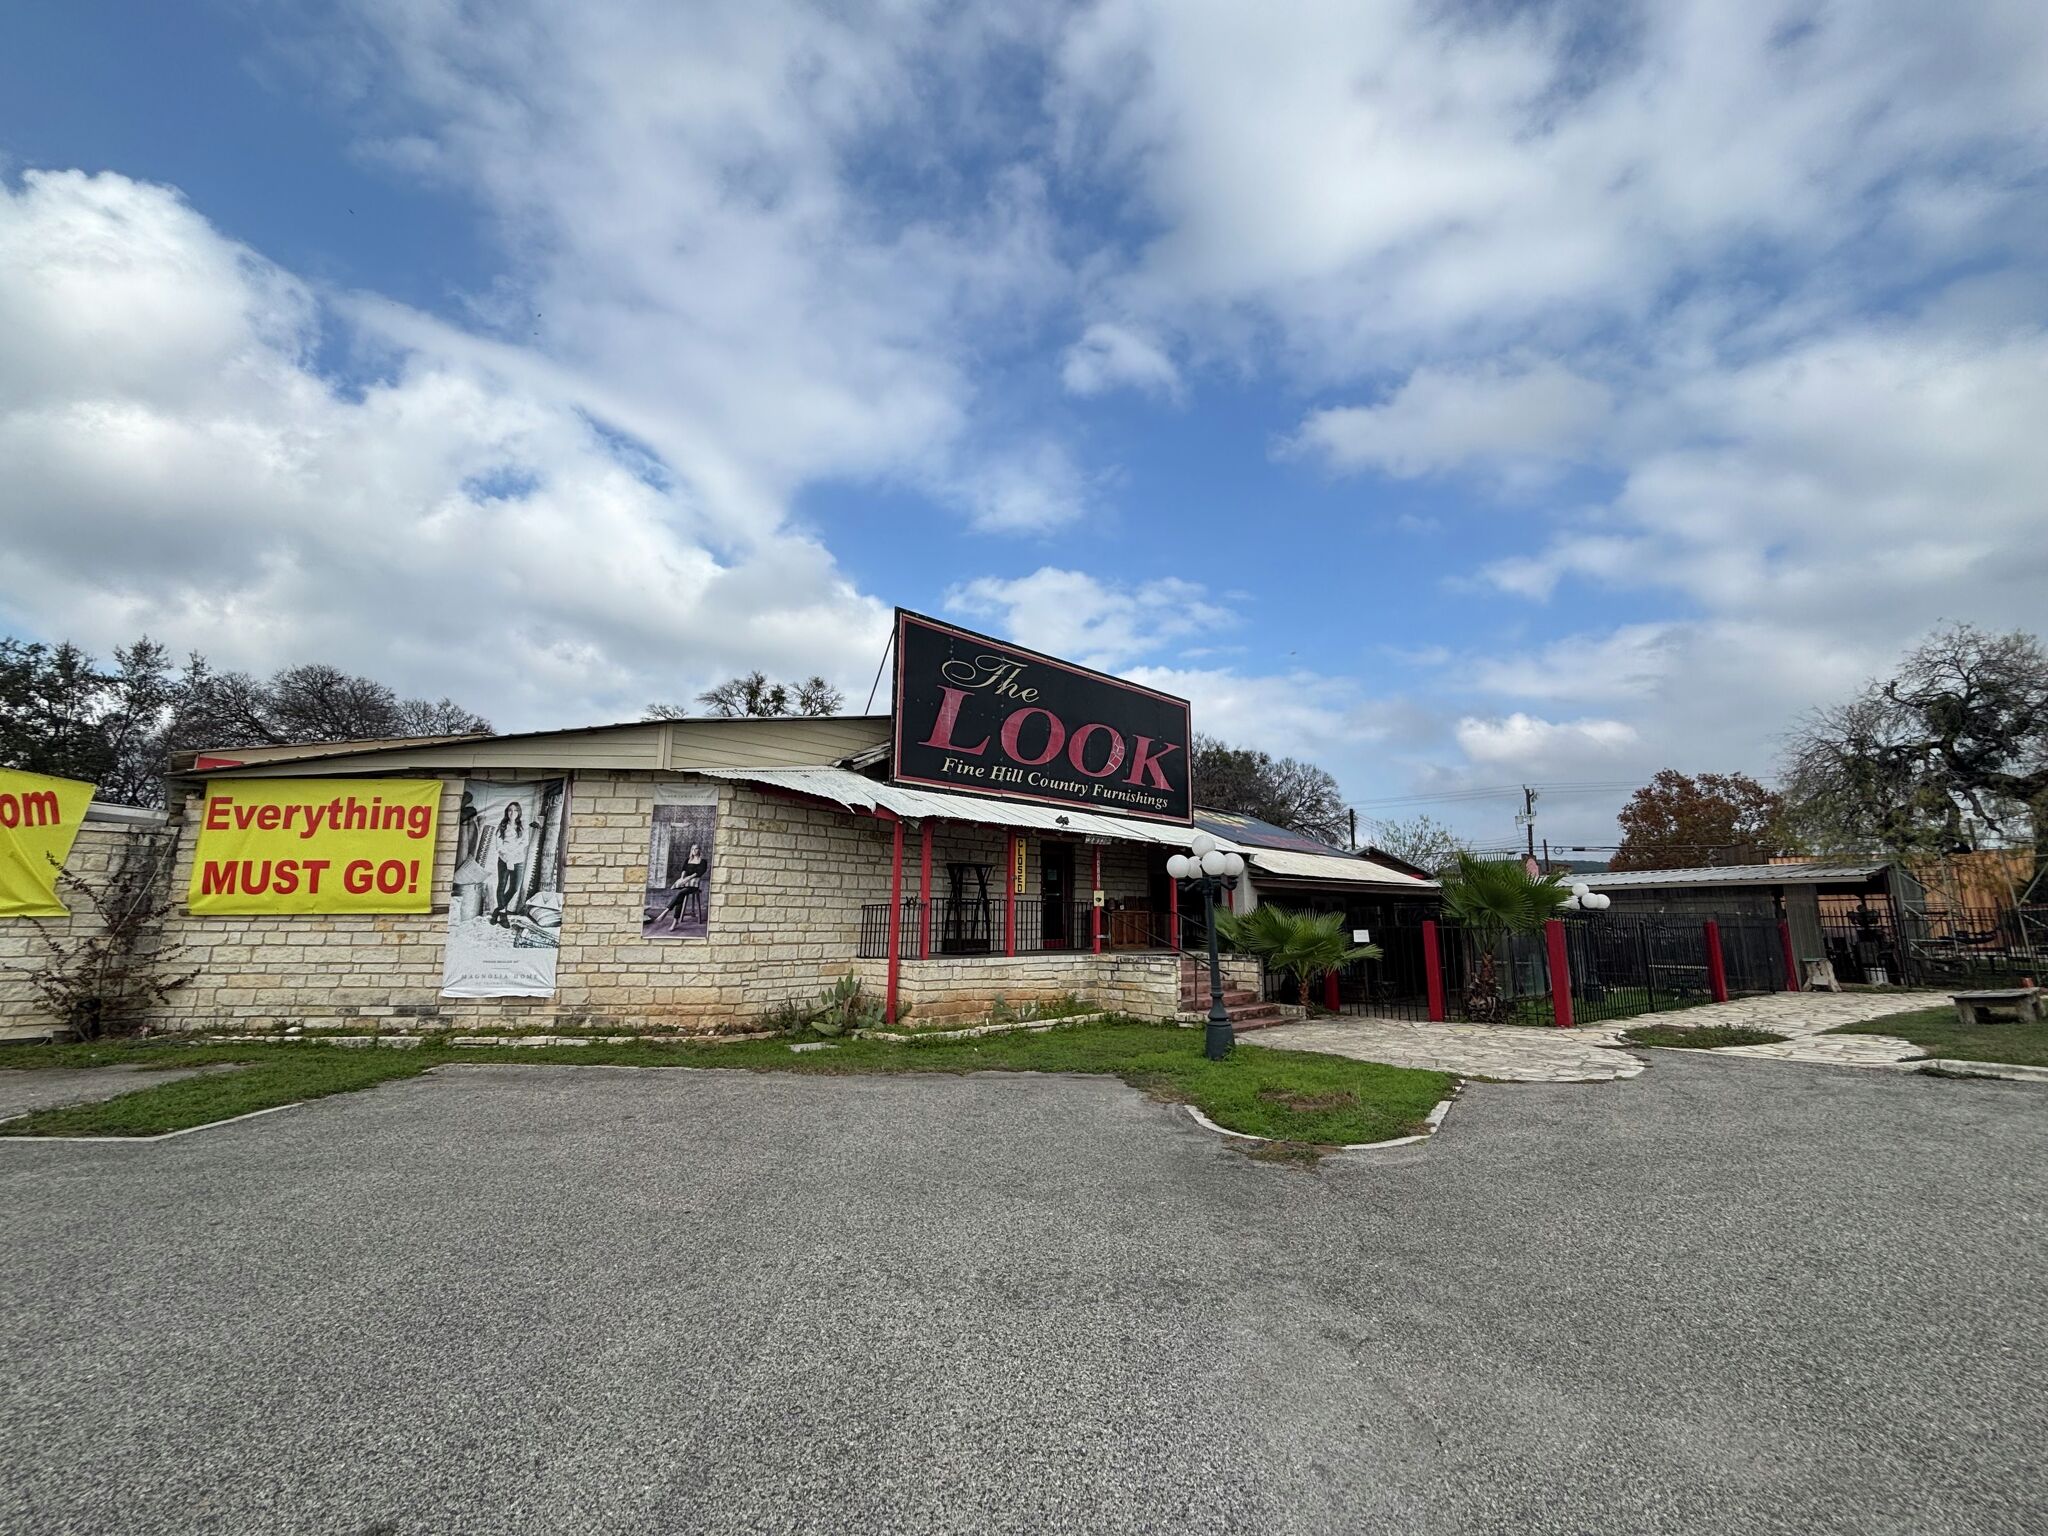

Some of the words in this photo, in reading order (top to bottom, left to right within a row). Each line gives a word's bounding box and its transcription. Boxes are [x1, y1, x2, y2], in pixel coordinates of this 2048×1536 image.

[942, 655, 1040, 703] The
[917, 684, 1181, 793] LOOK
[941, 757, 985, 778] Fine
[990, 766, 1024, 784] Hill
[1027, 771, 1089, 796] Country
[1092, 783, 1169, 809] Furnishings
[206, 796, 433, 839] Everything
[202, 860, 331, 895] MUST
[343, 859, 421, 895] GO!
